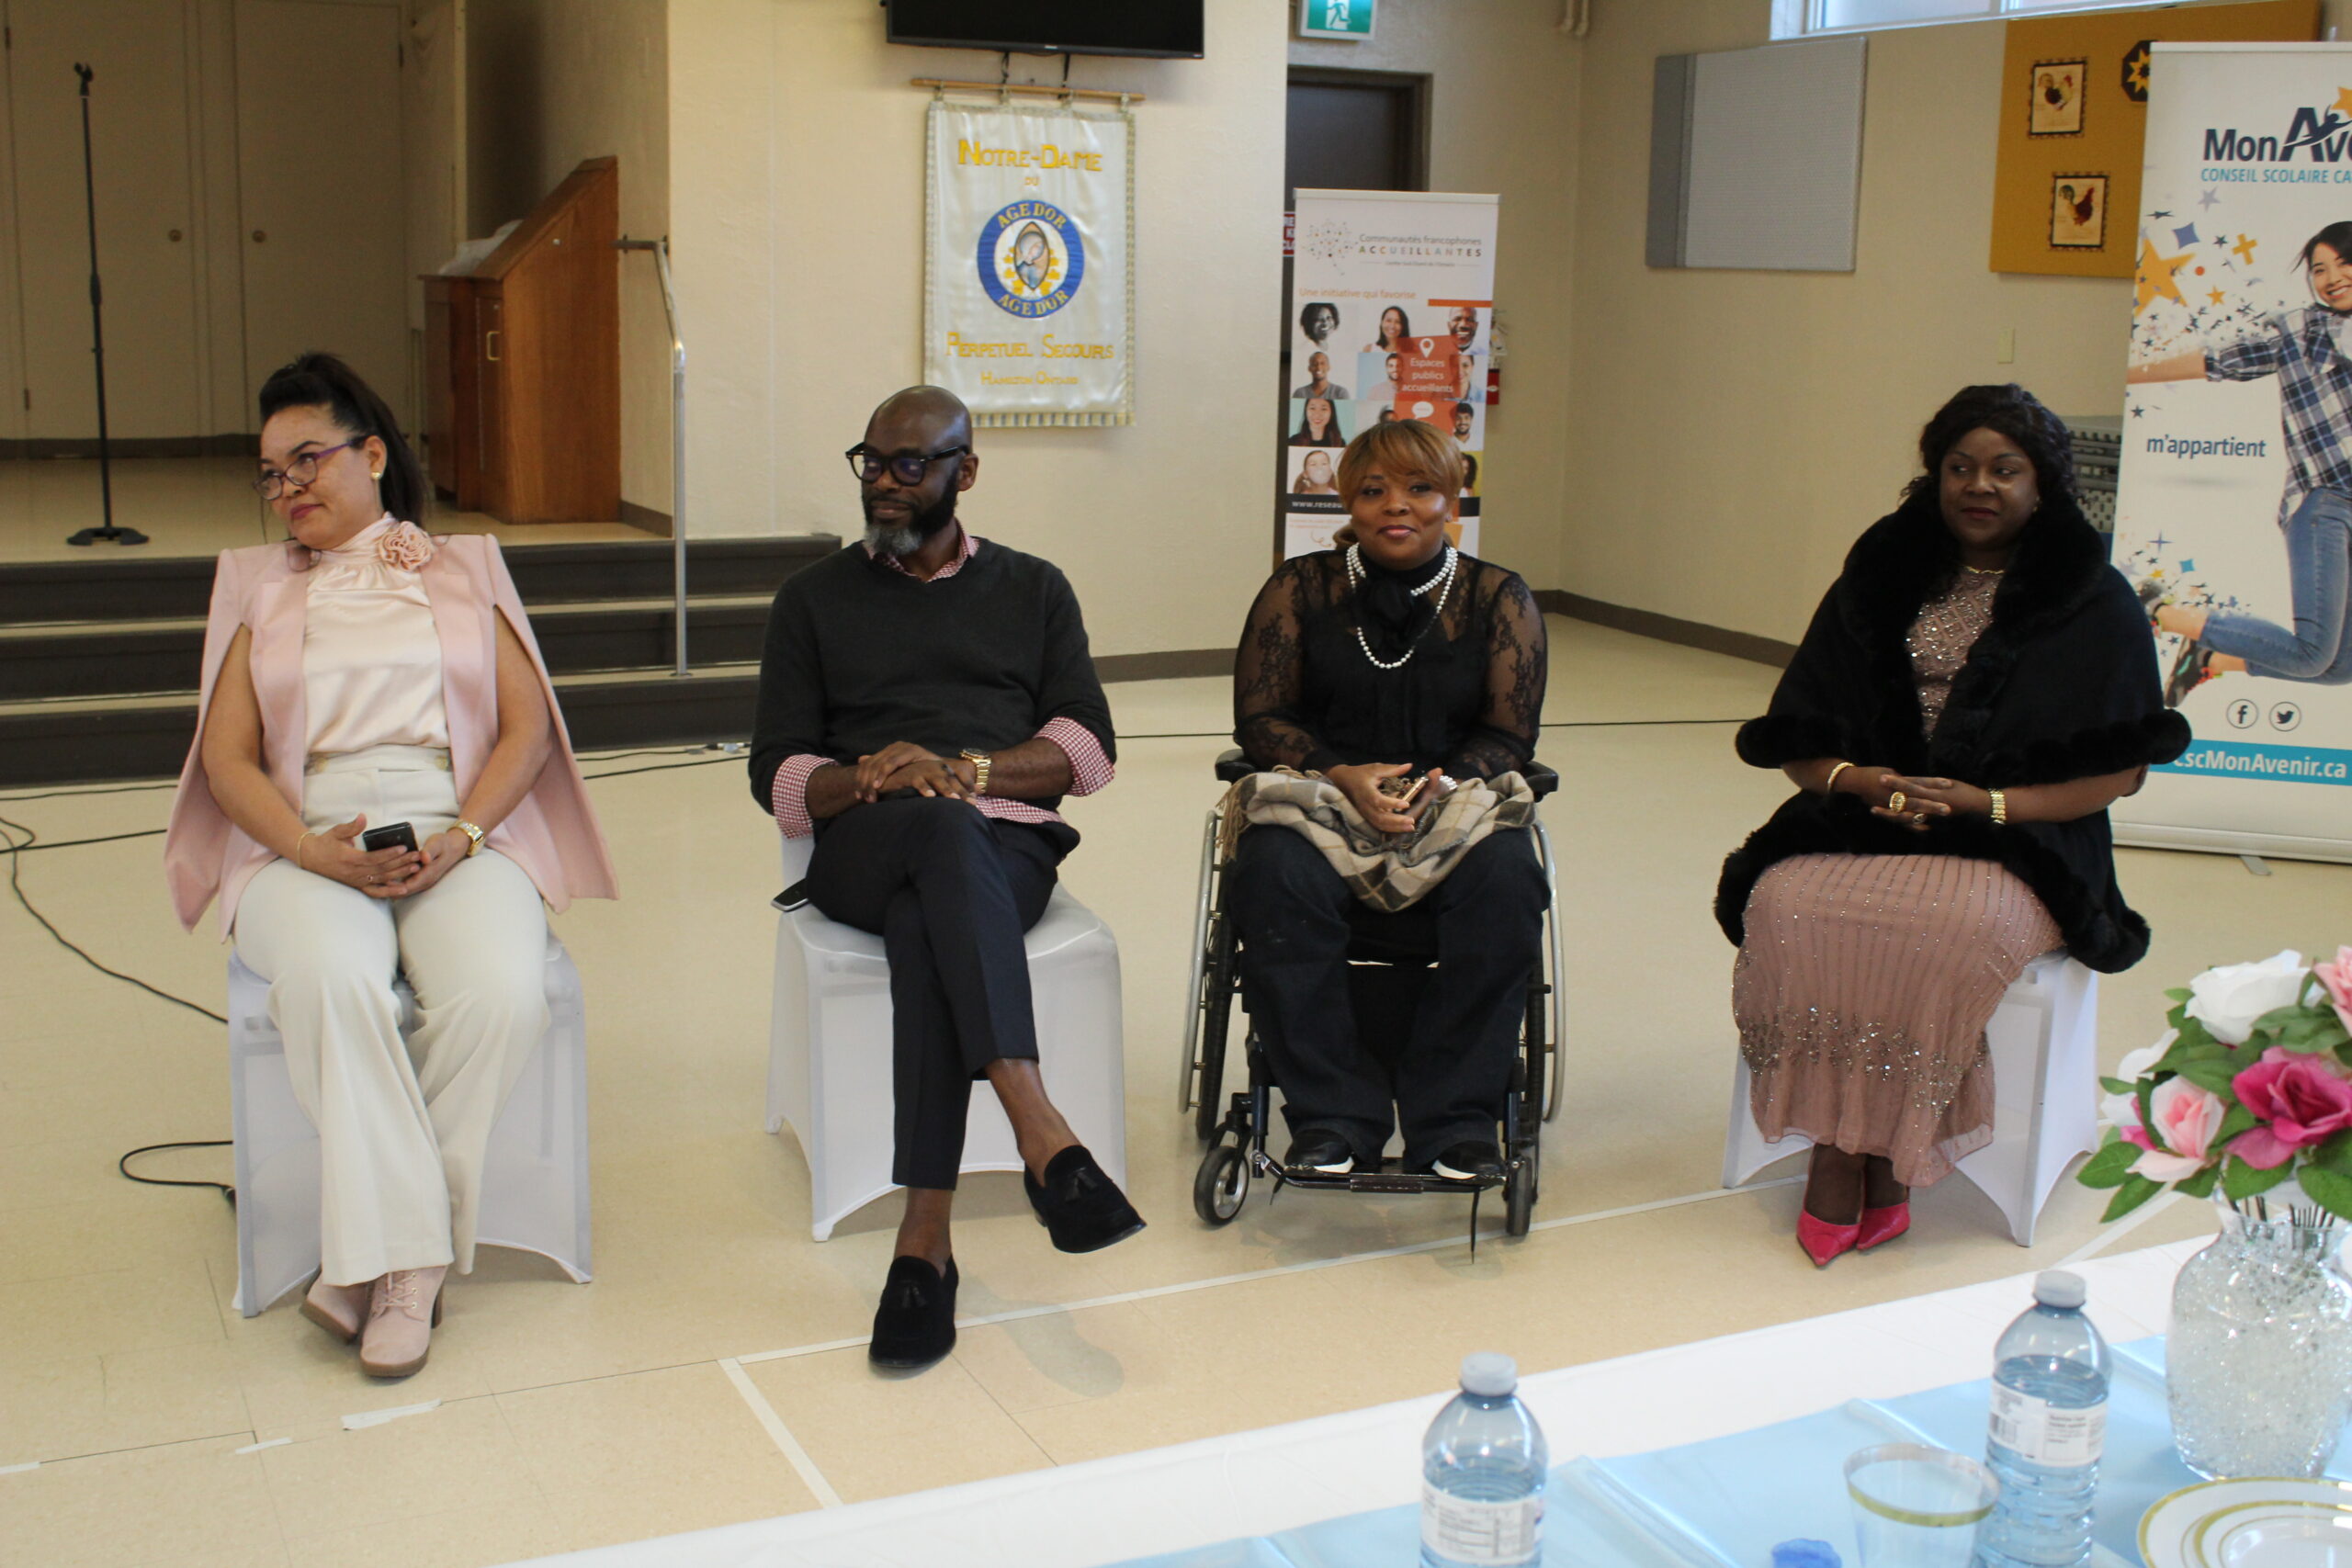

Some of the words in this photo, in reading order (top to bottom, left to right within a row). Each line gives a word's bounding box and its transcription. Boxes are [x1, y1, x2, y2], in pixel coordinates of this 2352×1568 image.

[2200, 168, 2257, 183] CONSEIL
[2262, 169, 2329, 184] SCOLAIRE
[998, 203, 1030, 229] AGE
[1424, 235, 1482, 245] francophones
[1359, 245, 1482, 257] ACCUEILLANTES
[1299, 288, 1318, 298] Une
[1320, 288, 1361, 299] initiative
[1380, 290, 1417, 299] favorise
[999, 294, 1032, 315] AGE
[1410, 358, 1445, 369] Espaces
[1412, 371, 1445, 380] publics
[1402, 383, 1454, 393] accueillants
[2147, 434, 2267, 459] m'appartient
[2174, 750, 2347, 779] scMonAvenir.ca
